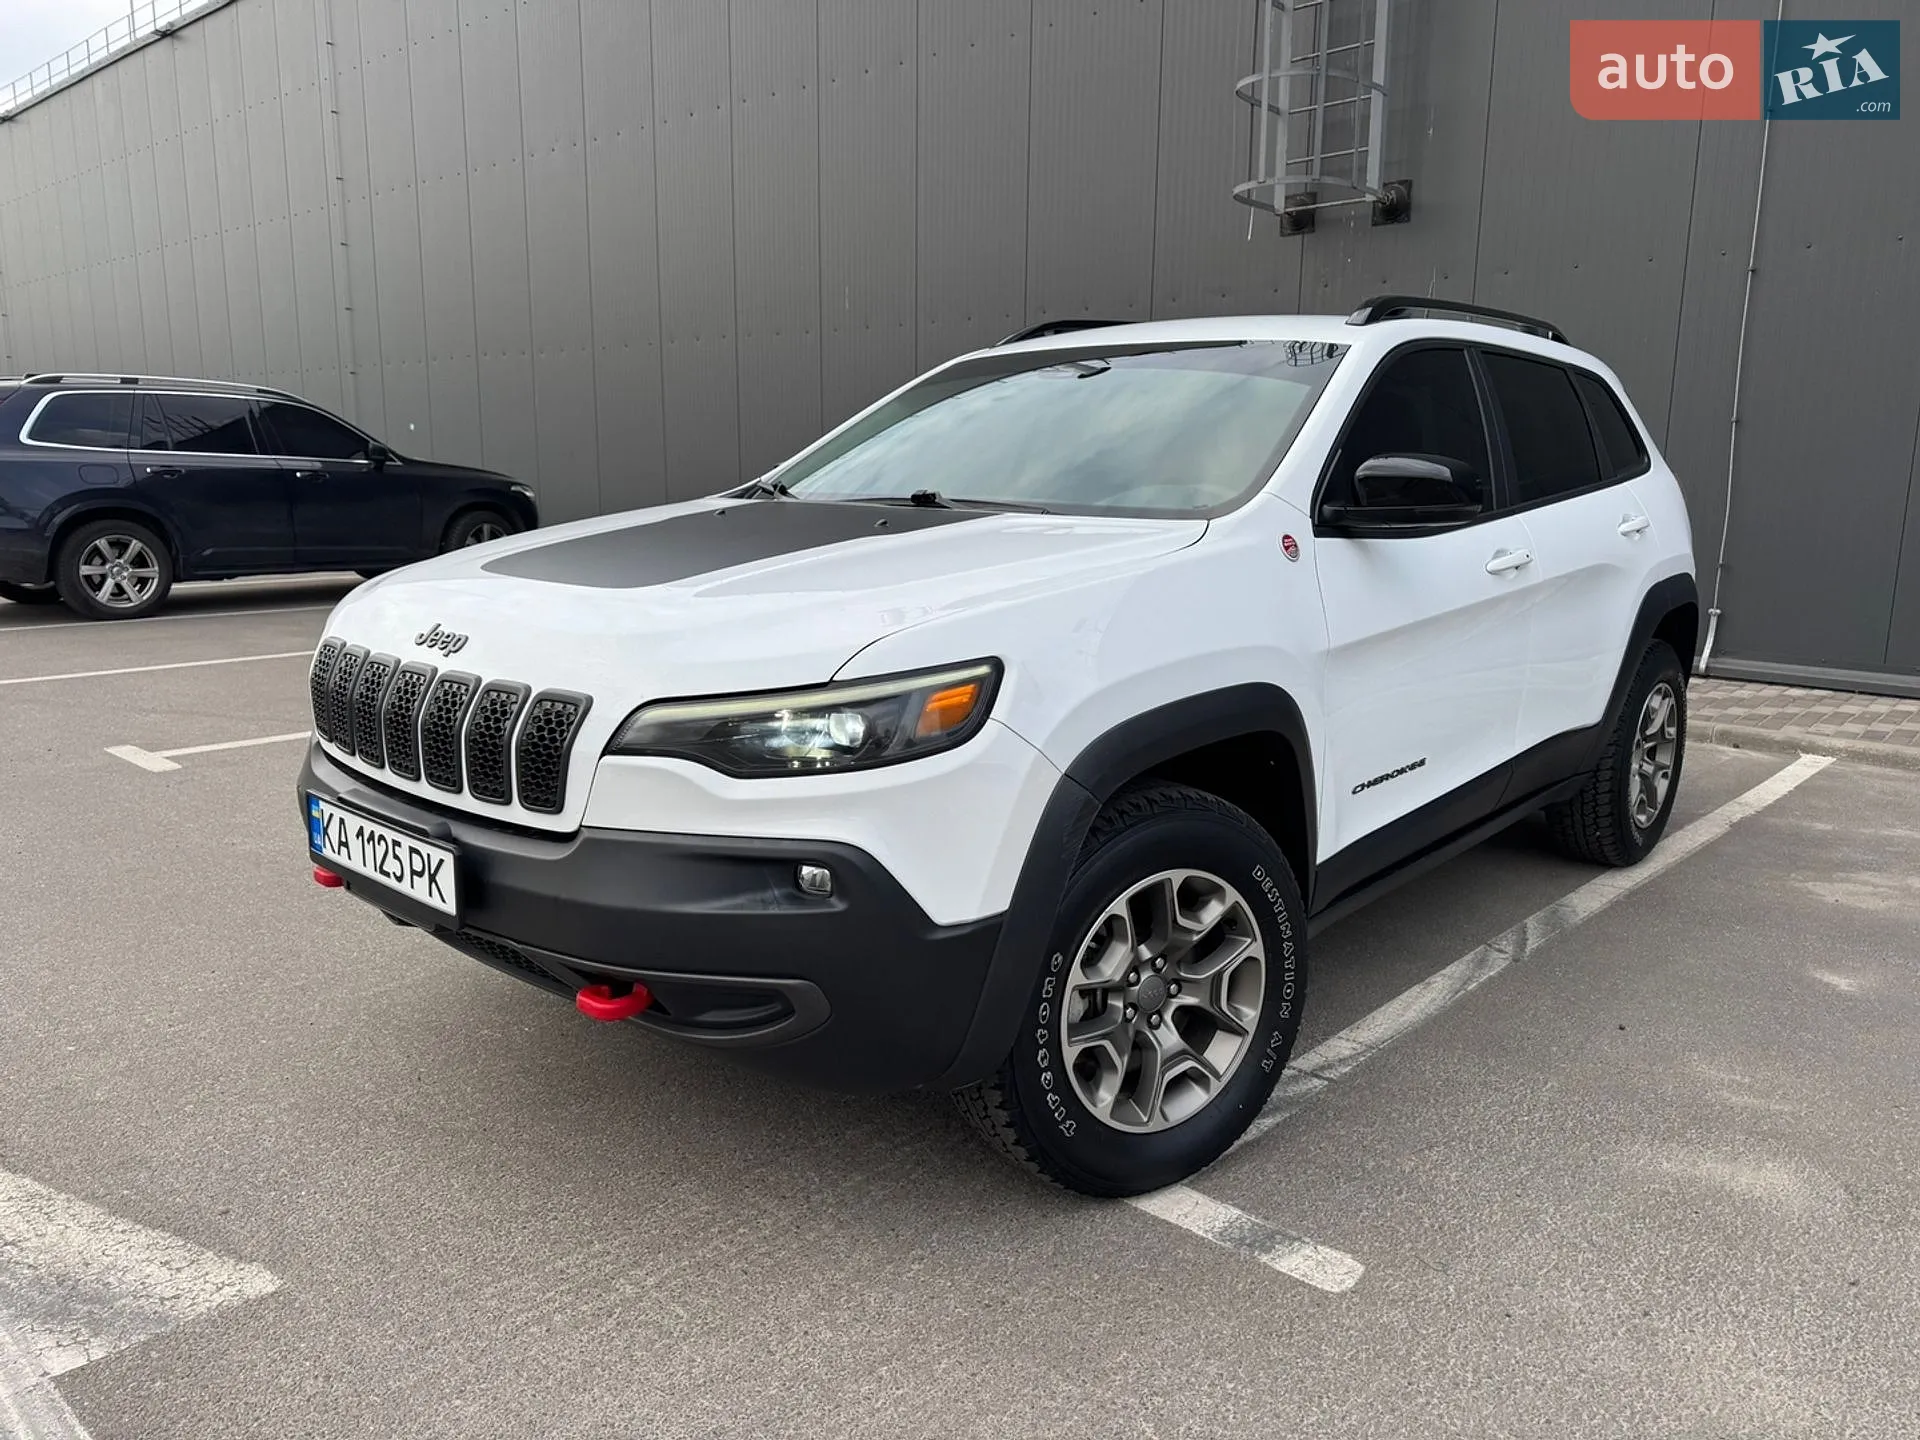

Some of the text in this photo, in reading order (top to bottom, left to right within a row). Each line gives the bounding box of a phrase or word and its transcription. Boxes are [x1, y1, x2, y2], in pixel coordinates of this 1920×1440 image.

[414, 622, 469, 657] Jeep
[1351, 757, 1427, 795] CHEROKEE
[320, 808, 448, 904] KA 1125 PK
[1251, 864, 1296, 1073] DESTINATION A/T
